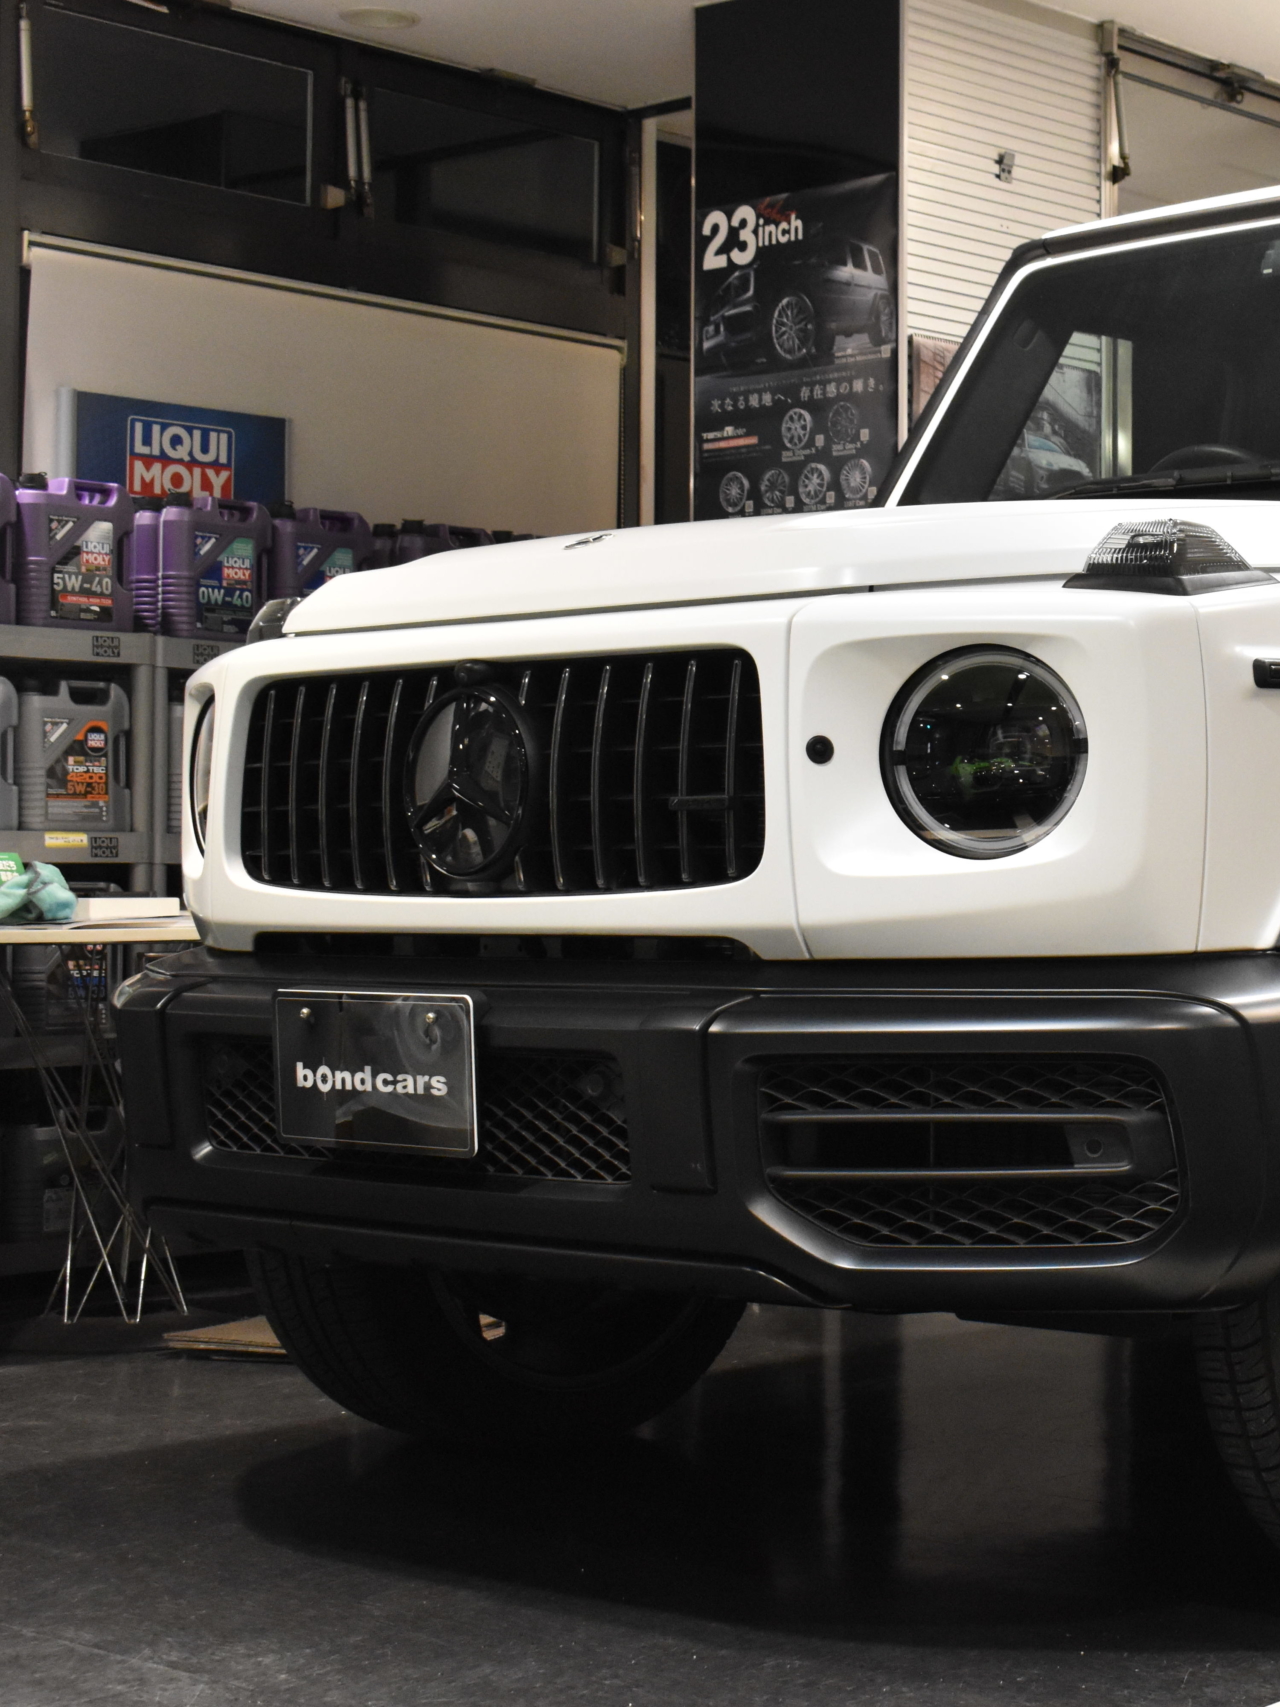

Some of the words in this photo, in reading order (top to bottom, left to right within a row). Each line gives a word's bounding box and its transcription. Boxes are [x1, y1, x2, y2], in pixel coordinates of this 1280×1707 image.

[134, 421, 228, 465] LIQUI
[133, 459, 231, 499] MOLY
[82, 541, 110, 554] LIQUI
[82, 552, 111, 566] MOLY
[224, 556, 250, 569] LIQUI
[223, 568, 251, 580] MOLY
[53, 572, 112, 595] 5W-40
[198, 586, 252, 608] 0W-40
[93, 636, 119, 646] LIQUI
[93, 646, 120, 656] MOLY
[194, 644, 219, 655] LIQUI
[87, 732, 105, 740] LIQUI
[87, 740, 105, 748] MOLY
[68, 765, 87, 773] TOP
[67, 772, 106, 783] 4200
[67, 781, 106, 795] 5W-30
[92, 837, 118, 847] LIQUI
[92, 848, 118, 857] MOLY
